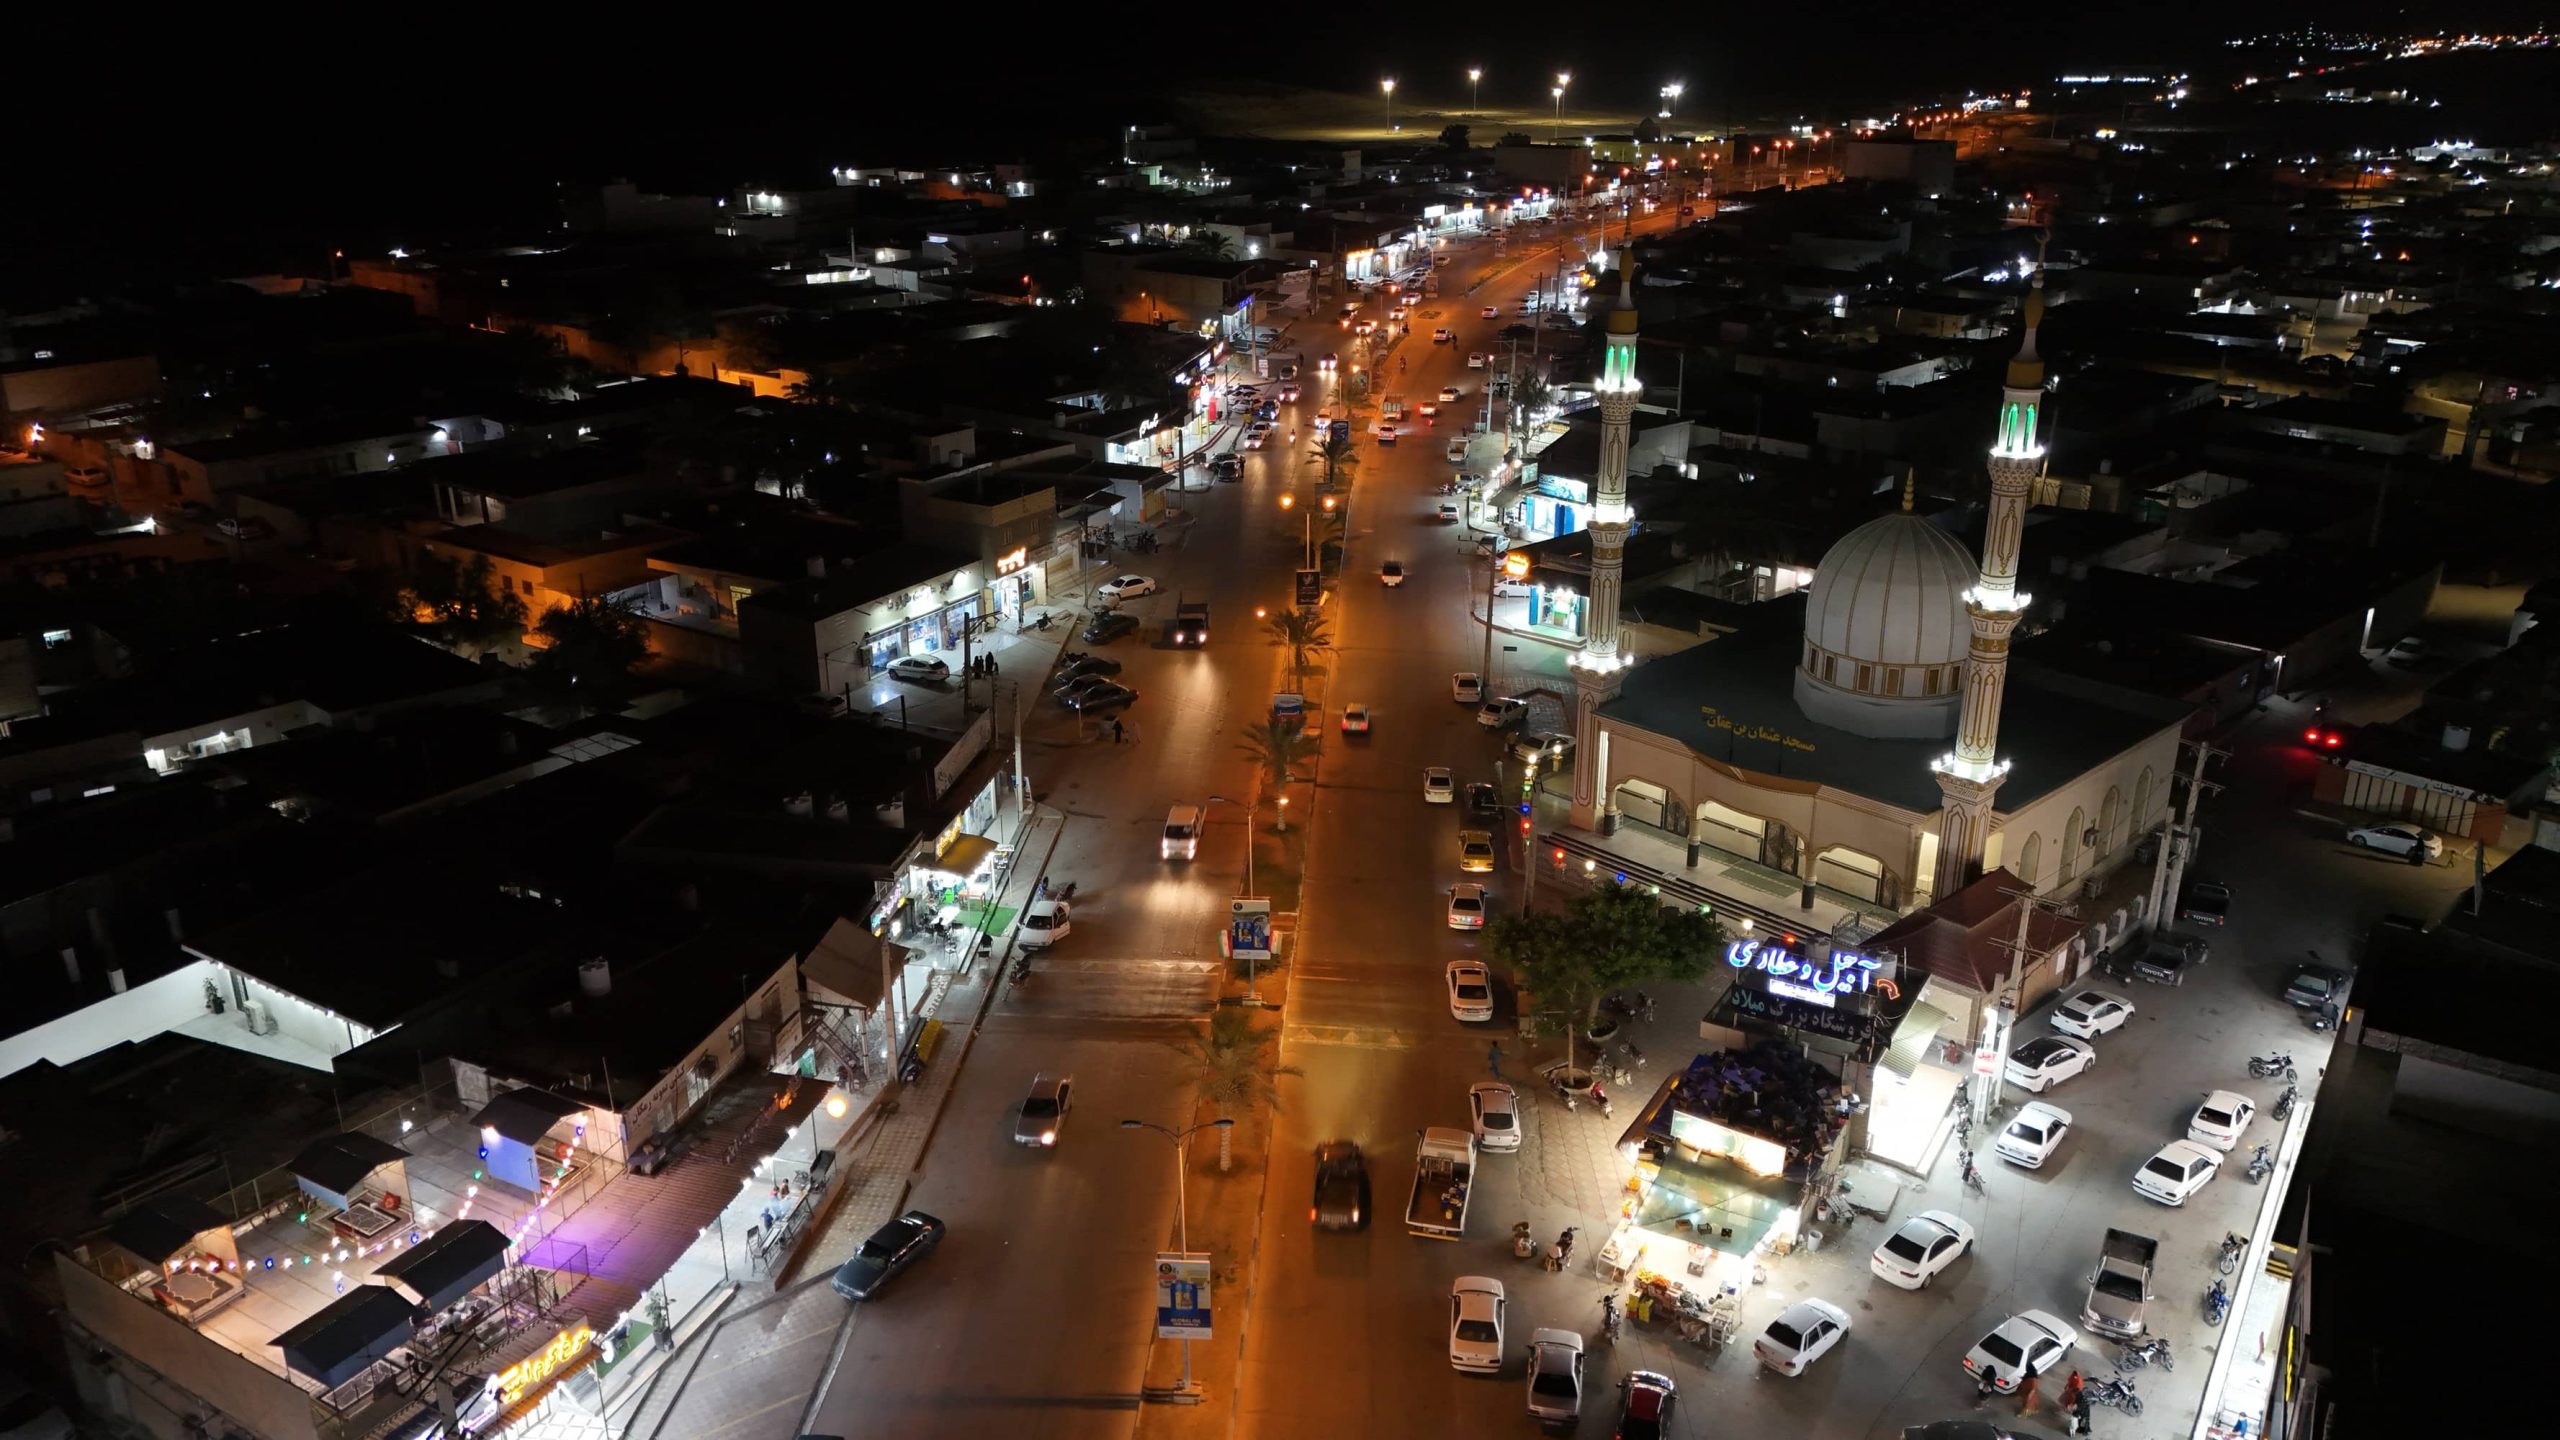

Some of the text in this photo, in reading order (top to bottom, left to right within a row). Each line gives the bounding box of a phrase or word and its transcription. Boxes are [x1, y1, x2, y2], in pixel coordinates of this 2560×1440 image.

[1733, 722, 1747, 737] بن
[1748, 726, 1781, 742] عثمان
[1782, 735, 1816, 752] مسجد
[2192, 914, 2216, 923] TOYOTA
[1729, 940, 1799, 976] عطاری
[1800, 963, 1812, 981] و
[1813, 951, 1882, 993] آجیل
[2141, 967, 2165, 978] TOYOTA
[1731, 988, 1765, 1016] میلاد
[1812, 1011, 1872, 1043] فروشگاه
